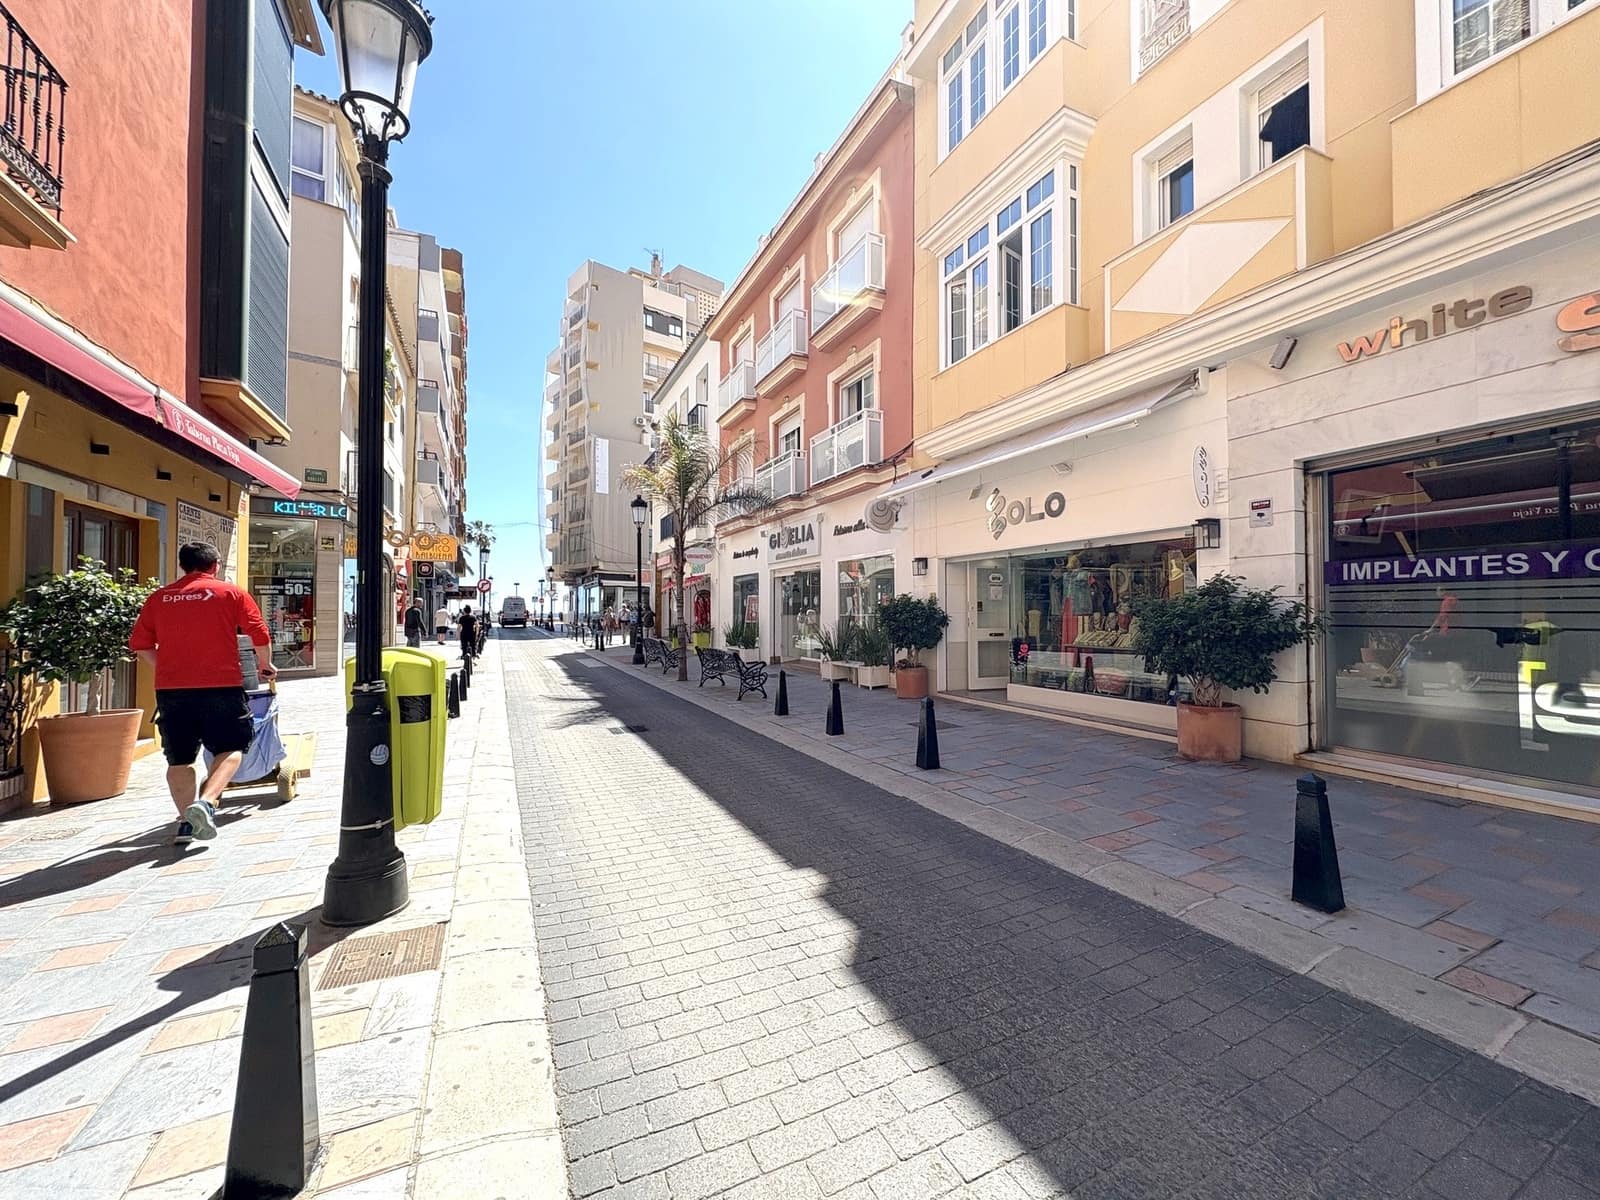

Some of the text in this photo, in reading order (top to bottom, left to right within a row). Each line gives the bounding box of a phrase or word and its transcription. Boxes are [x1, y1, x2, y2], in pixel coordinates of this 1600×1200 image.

[1337, 285, 1533, 363] white
[1342, 552, 1529, 580] IMPLANTES
[1541, 550, 1569, 573] Y
[162, 592, 203, 603] Express
